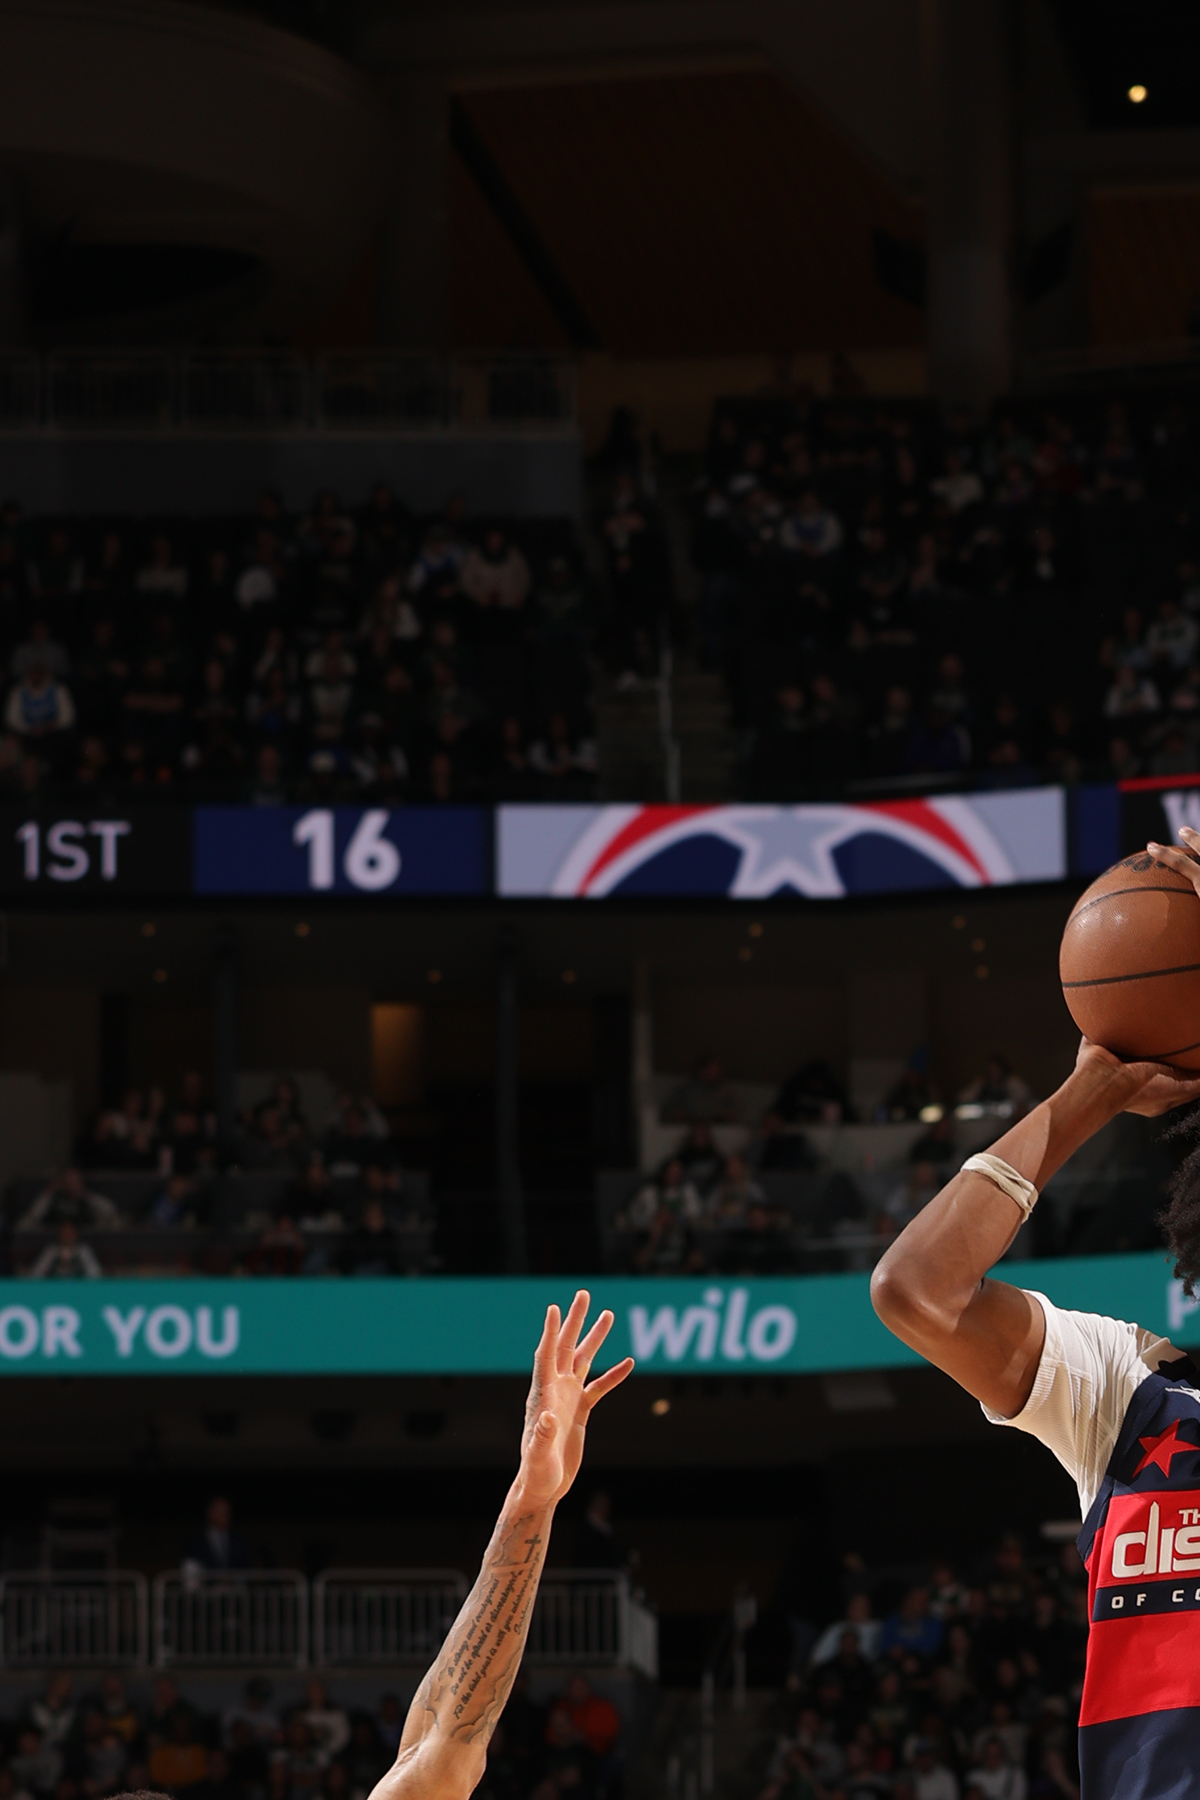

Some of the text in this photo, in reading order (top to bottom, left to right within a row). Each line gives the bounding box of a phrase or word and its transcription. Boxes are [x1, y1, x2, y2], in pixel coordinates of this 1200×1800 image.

[16, 822, 130, 881] 1ST
[294, 809, 401, 891] 16
[103, 1304, 239, 1358] YOU
[629, 1286, 796, 1361] wilo
[1111, 1593, 1147, 1609] OF
